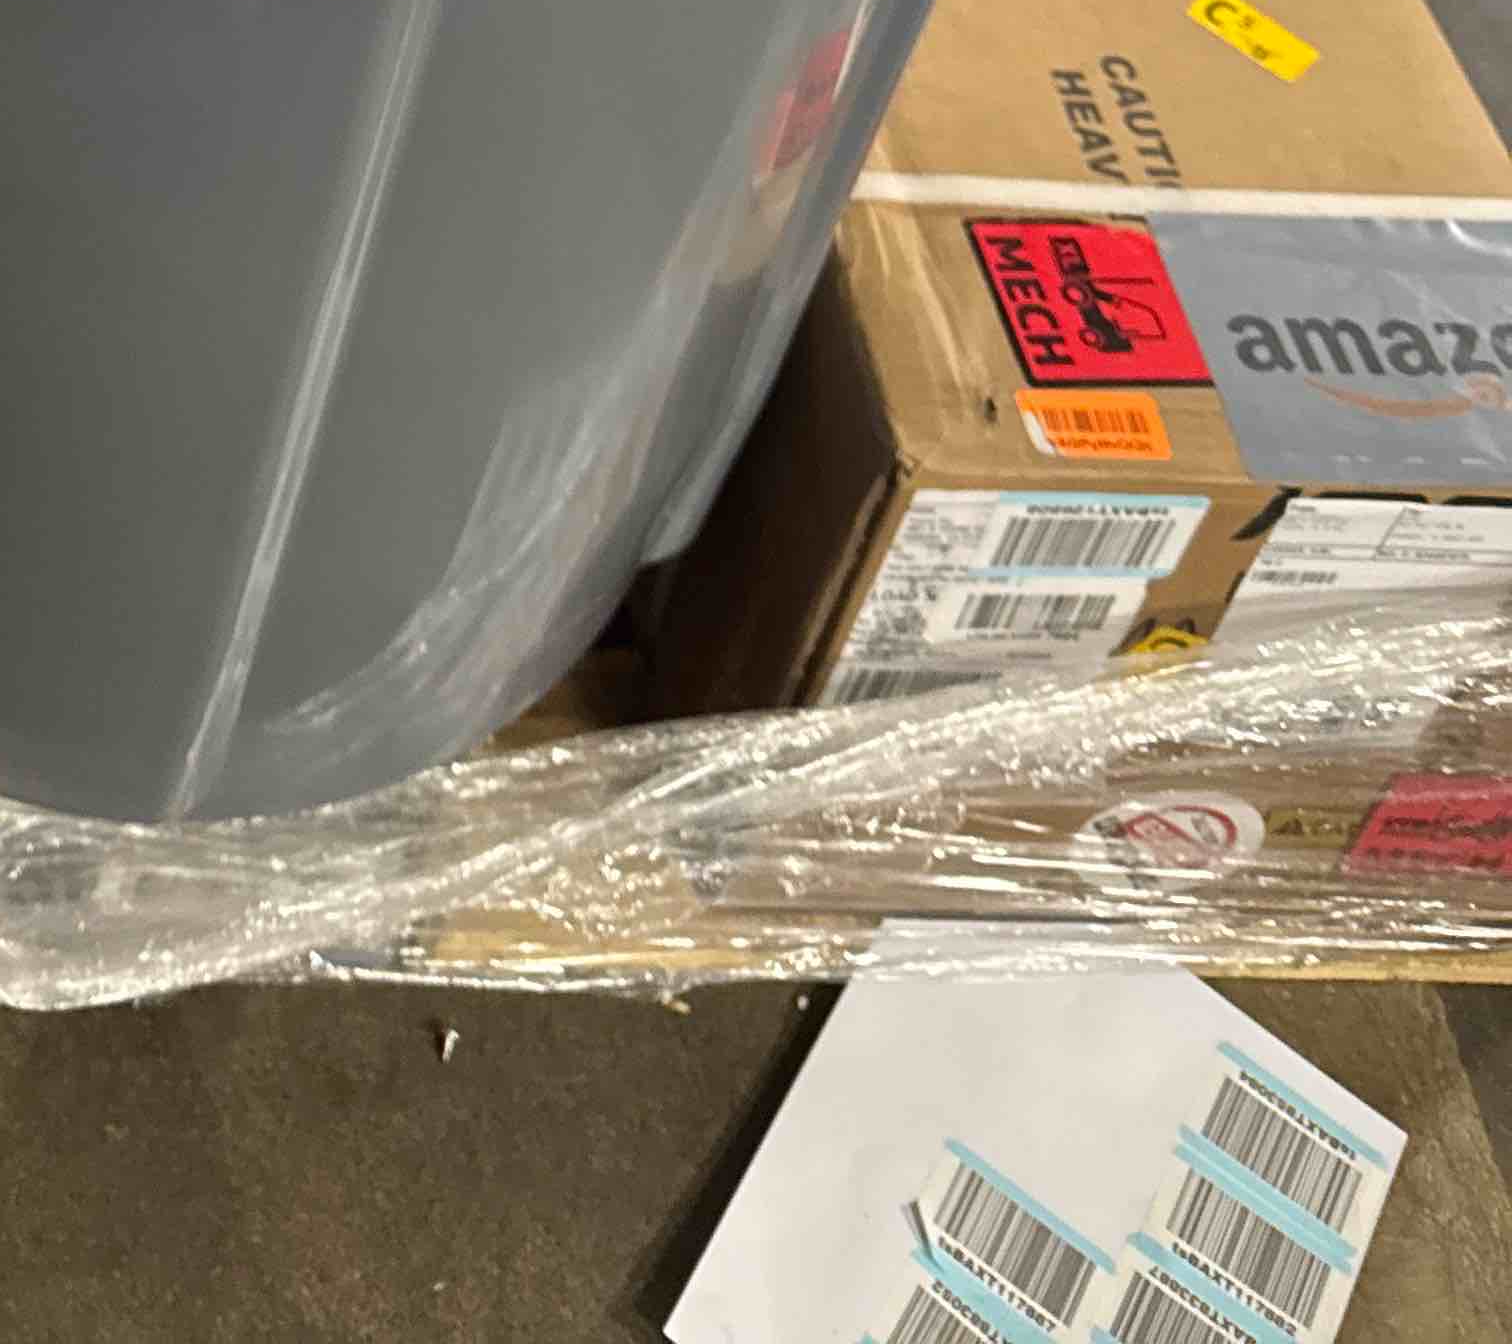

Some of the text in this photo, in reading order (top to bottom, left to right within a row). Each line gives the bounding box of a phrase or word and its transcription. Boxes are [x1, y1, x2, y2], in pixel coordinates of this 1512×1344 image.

[1049, 67, 1131, 184] HEAV
[1099, 53, 1182, 188] CAUTI
[984, 235, 1078, 367] MECH
